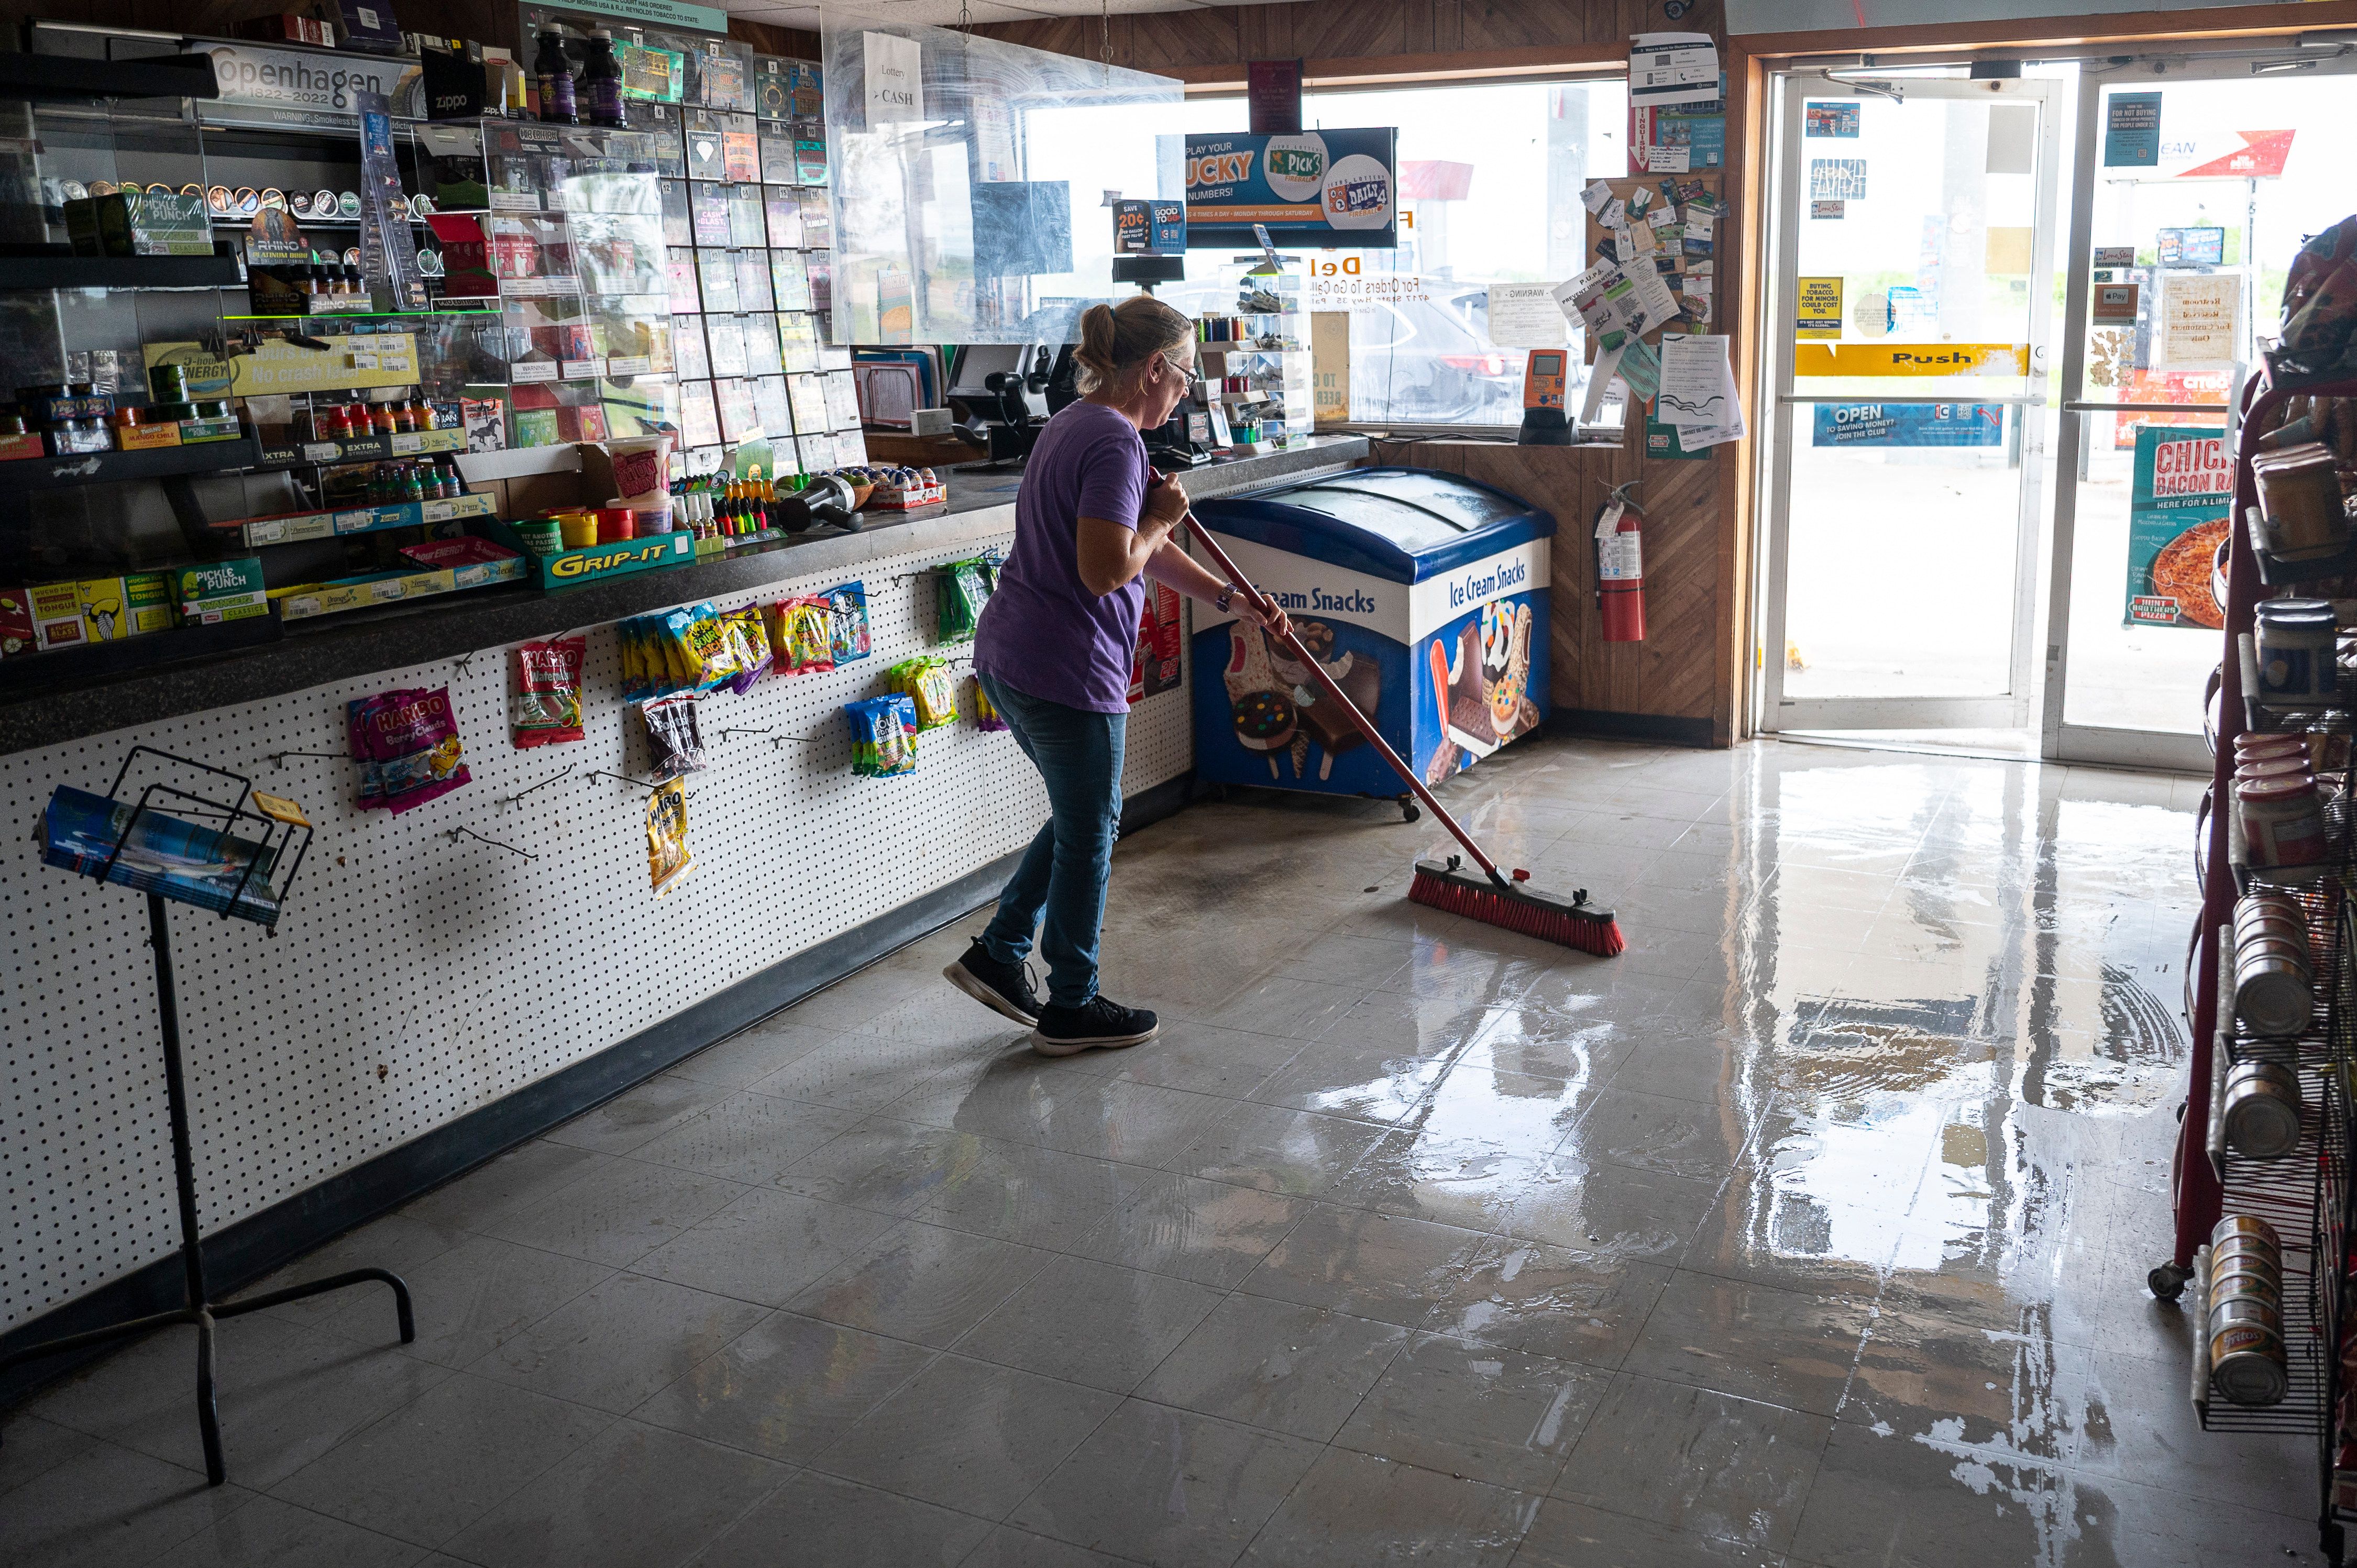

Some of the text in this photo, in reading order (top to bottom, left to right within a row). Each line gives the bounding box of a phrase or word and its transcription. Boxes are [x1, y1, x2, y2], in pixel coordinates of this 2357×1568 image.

[649, 2, 673, 11] ORDERED
[626, 6, 653, 16] REYNOLDS
[654, 10, 677, 20] TOBACCO
[684, 15, 700, 24] STATE:
[210, 47, 381, 108] Copenhagen
[882, 65, 906, 80] Lottery
[436, 94, 467, 111] zippo
[882, 90, 913, 106] CASH
[273, 111, 350, 126] WARNING: Smokeless
[1186, 142, 1232, 156] PLAY YOUR
[1288, 153, 1321, 174] PICK 3
[1188, 187, 1233, 201] NUMBERS!
[1349, 184, 1387, 205] DAILY 4
[141, 199, 178, 210] PICKLE
[1154, 207, 1178, 216] GOOD
[153, 211, 190, 221] PUNCH
[1349, 208, 1379, 218] FIREBALL
[1119, 213, 1144, 228] 20¢
[258, 240, 299, 251] RHINO
[1561, 260, 1628, 305] PREVENT UNWANTED PETS
[1579, 269, 1604, 285] P.U.P.S.
[311, 301, 346, 310] RHINO
[751, 338, 774, 356] 200
[1892, 352, 1972, 365] Push
[252, 365, 322, 383] No crash
[1834, 404, 1882, 424] OPEN
[1837, 423, 1865, 433] SAVING
[1865, 418, 1895, 429] MONEY?
[128, 434, 156, 442] MANGO
[1834, 433, 1852, 441] JOIN
[1867, 428, 1886, 437] CLUB
[347, 442, 381, 451] EXTRA
[263, 450, 295, 459] XTRA
[2156, 473, 2210, 495] BACON
[2157, 500, 2180, 510] HERE
[2182, 499, 2199, 507] FOR
[382, 513, 399, 522] Grape
[435, 543, 466, 560] ENERGY
[552, 545, 667, 576] GRIP-IT
[196, 567, 235, 581] PICKLE
[495, 564, 515, 576] decaf
[207, 576, 247, 590] PUNCH
[1450, 557, 1525, 609] Ice Cream Snacks
[35, 588, 59, 596] MUCHO
[130, 590, 166, 601] TONGUE
[327, 594, 346, 604] Orange
[38, 602, 76, 613] TONGUE
[1312, 588, 1375, 614] Snacks
[2132, 605, 2175, 613] BROTHERS
[51, 628, 76, 637] BLAST
[693, 630, 718, 648] SOUR
[697, 638, 725, 659] PATCH
[1160, 658, 1178, 680] 22
[376, 696, 445, 733] HARIBO
